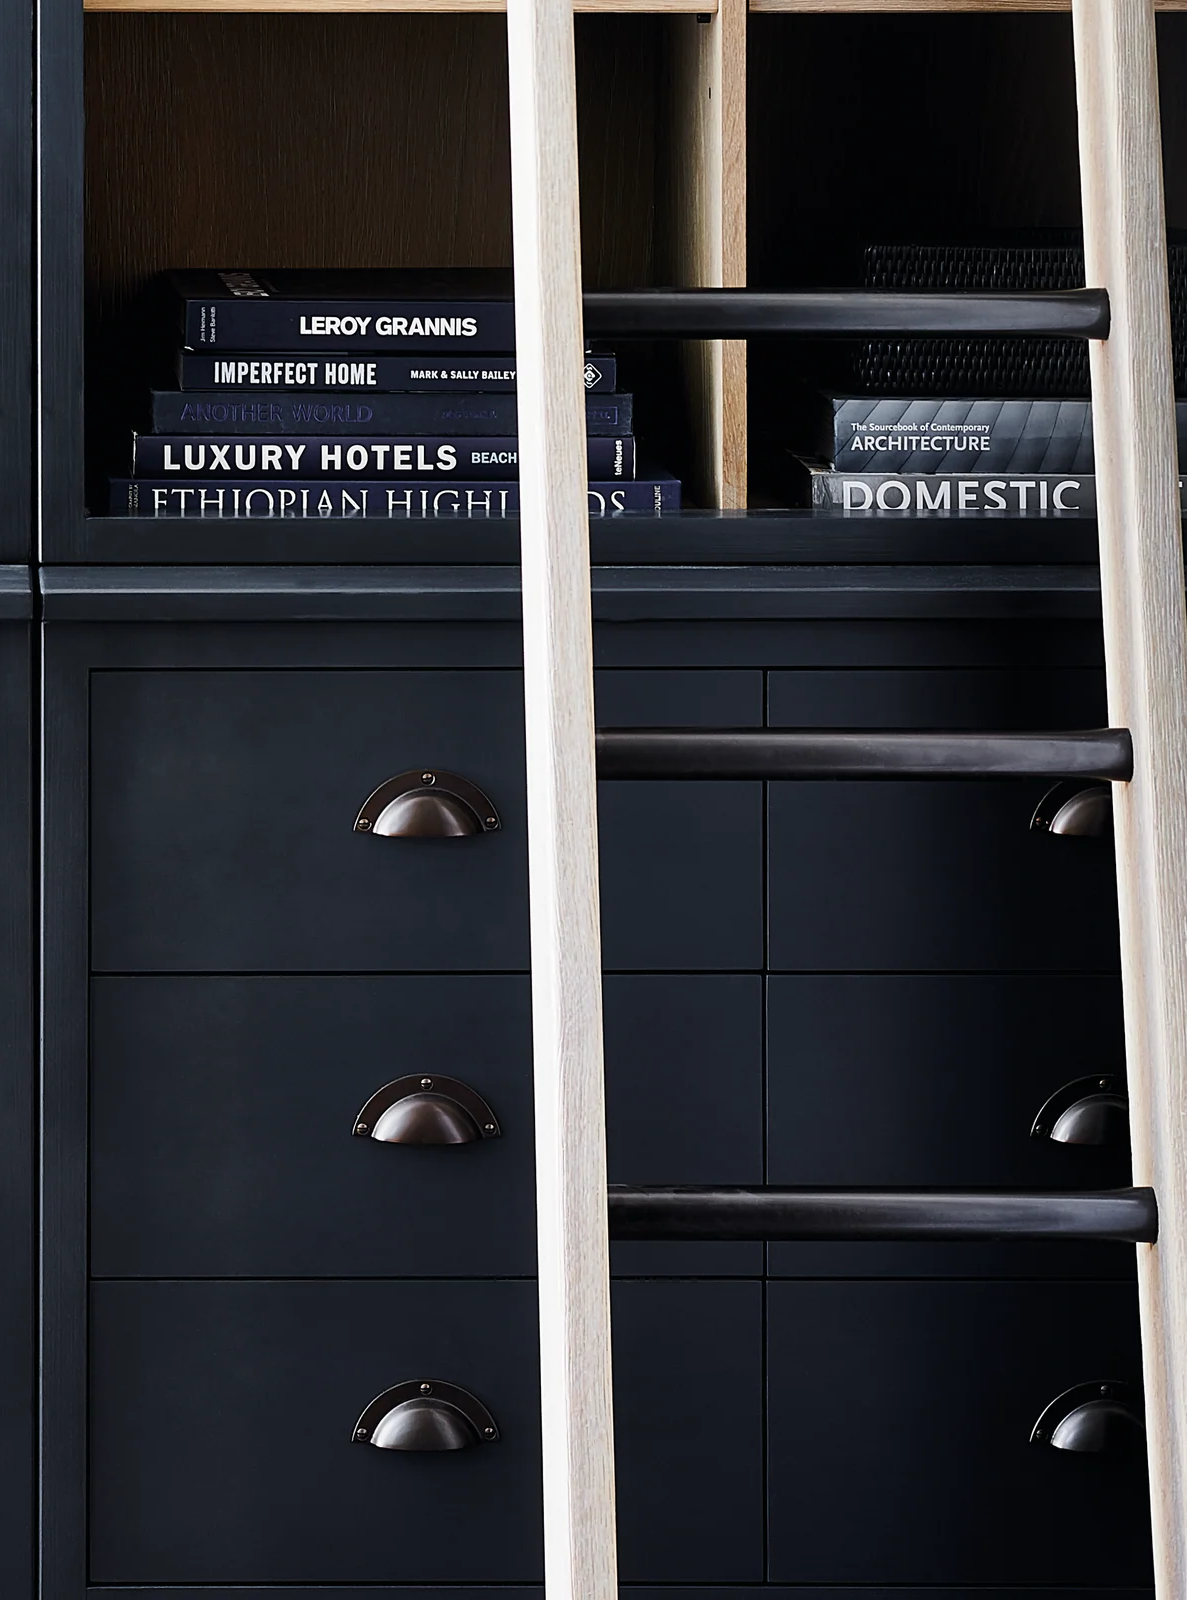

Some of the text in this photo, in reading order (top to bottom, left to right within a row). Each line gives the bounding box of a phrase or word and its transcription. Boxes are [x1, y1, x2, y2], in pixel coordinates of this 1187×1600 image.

[299, 316, 477, 337] LEROY GRANNIS
[214, 362, 516, 385] IMPERFECT HOME MARK & SALLY BAILEY
[180, 403, 373, 423] ANOTHER WORLD
[851, 423, 989, 433] The Sourcebook of Contemporary
[851, 436, 991, 450] ARCHITECTURE
[164, 444, 517, 470] LUXURY HOTELS BEACH
[843, 480, 1081, 510] DOMESTIC
